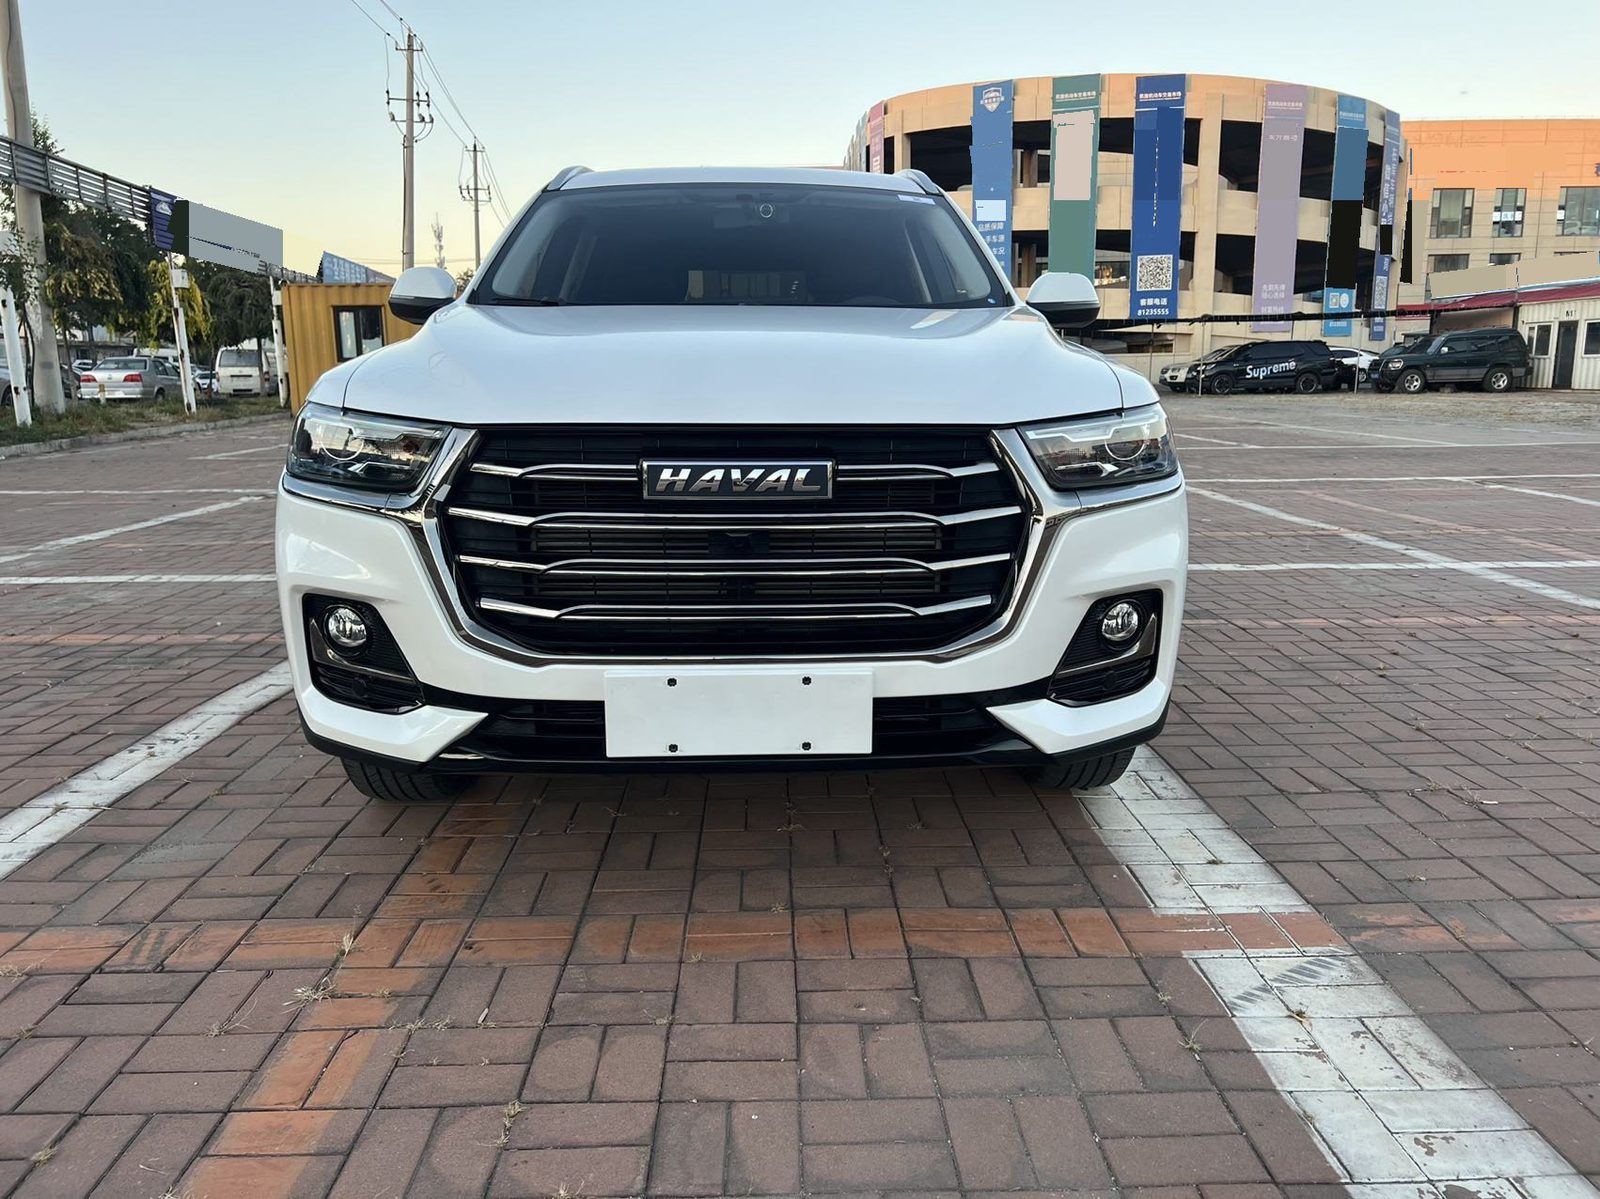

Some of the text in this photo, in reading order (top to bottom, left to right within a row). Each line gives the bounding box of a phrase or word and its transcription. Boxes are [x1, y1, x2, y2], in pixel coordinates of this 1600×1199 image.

[1140, 298, 1168, 306] 客服电话
[1137, 308, 1169, 316] 81235555
[1245, 361, 1296, 380] Supreme
[655, 468, 821, 492] HAVAL
